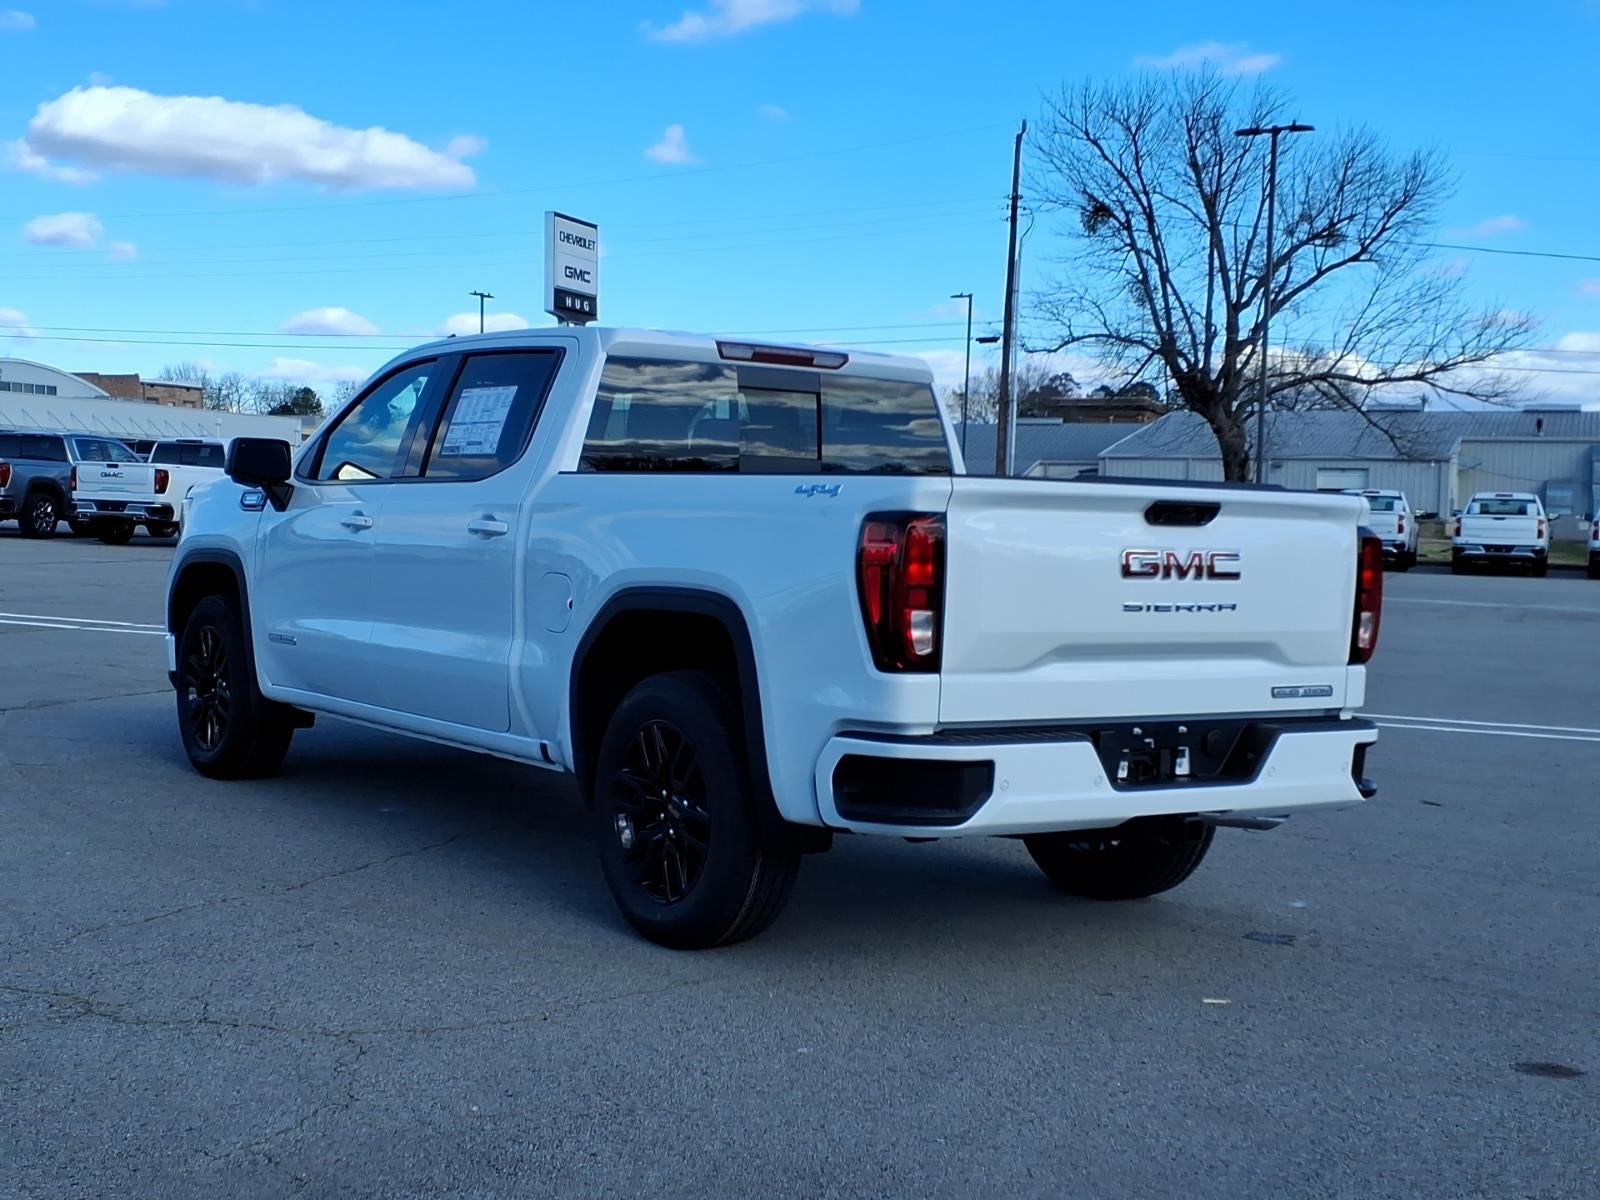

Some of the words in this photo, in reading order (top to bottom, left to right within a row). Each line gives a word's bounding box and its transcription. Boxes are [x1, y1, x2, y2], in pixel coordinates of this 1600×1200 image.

[560, 231, 595, 251] CHEVROLET
[564, 265, 591, 283] GMC
[1121, 550, 1241, 581] GMC
[1122, 602, 1237, 613] SIERRA
